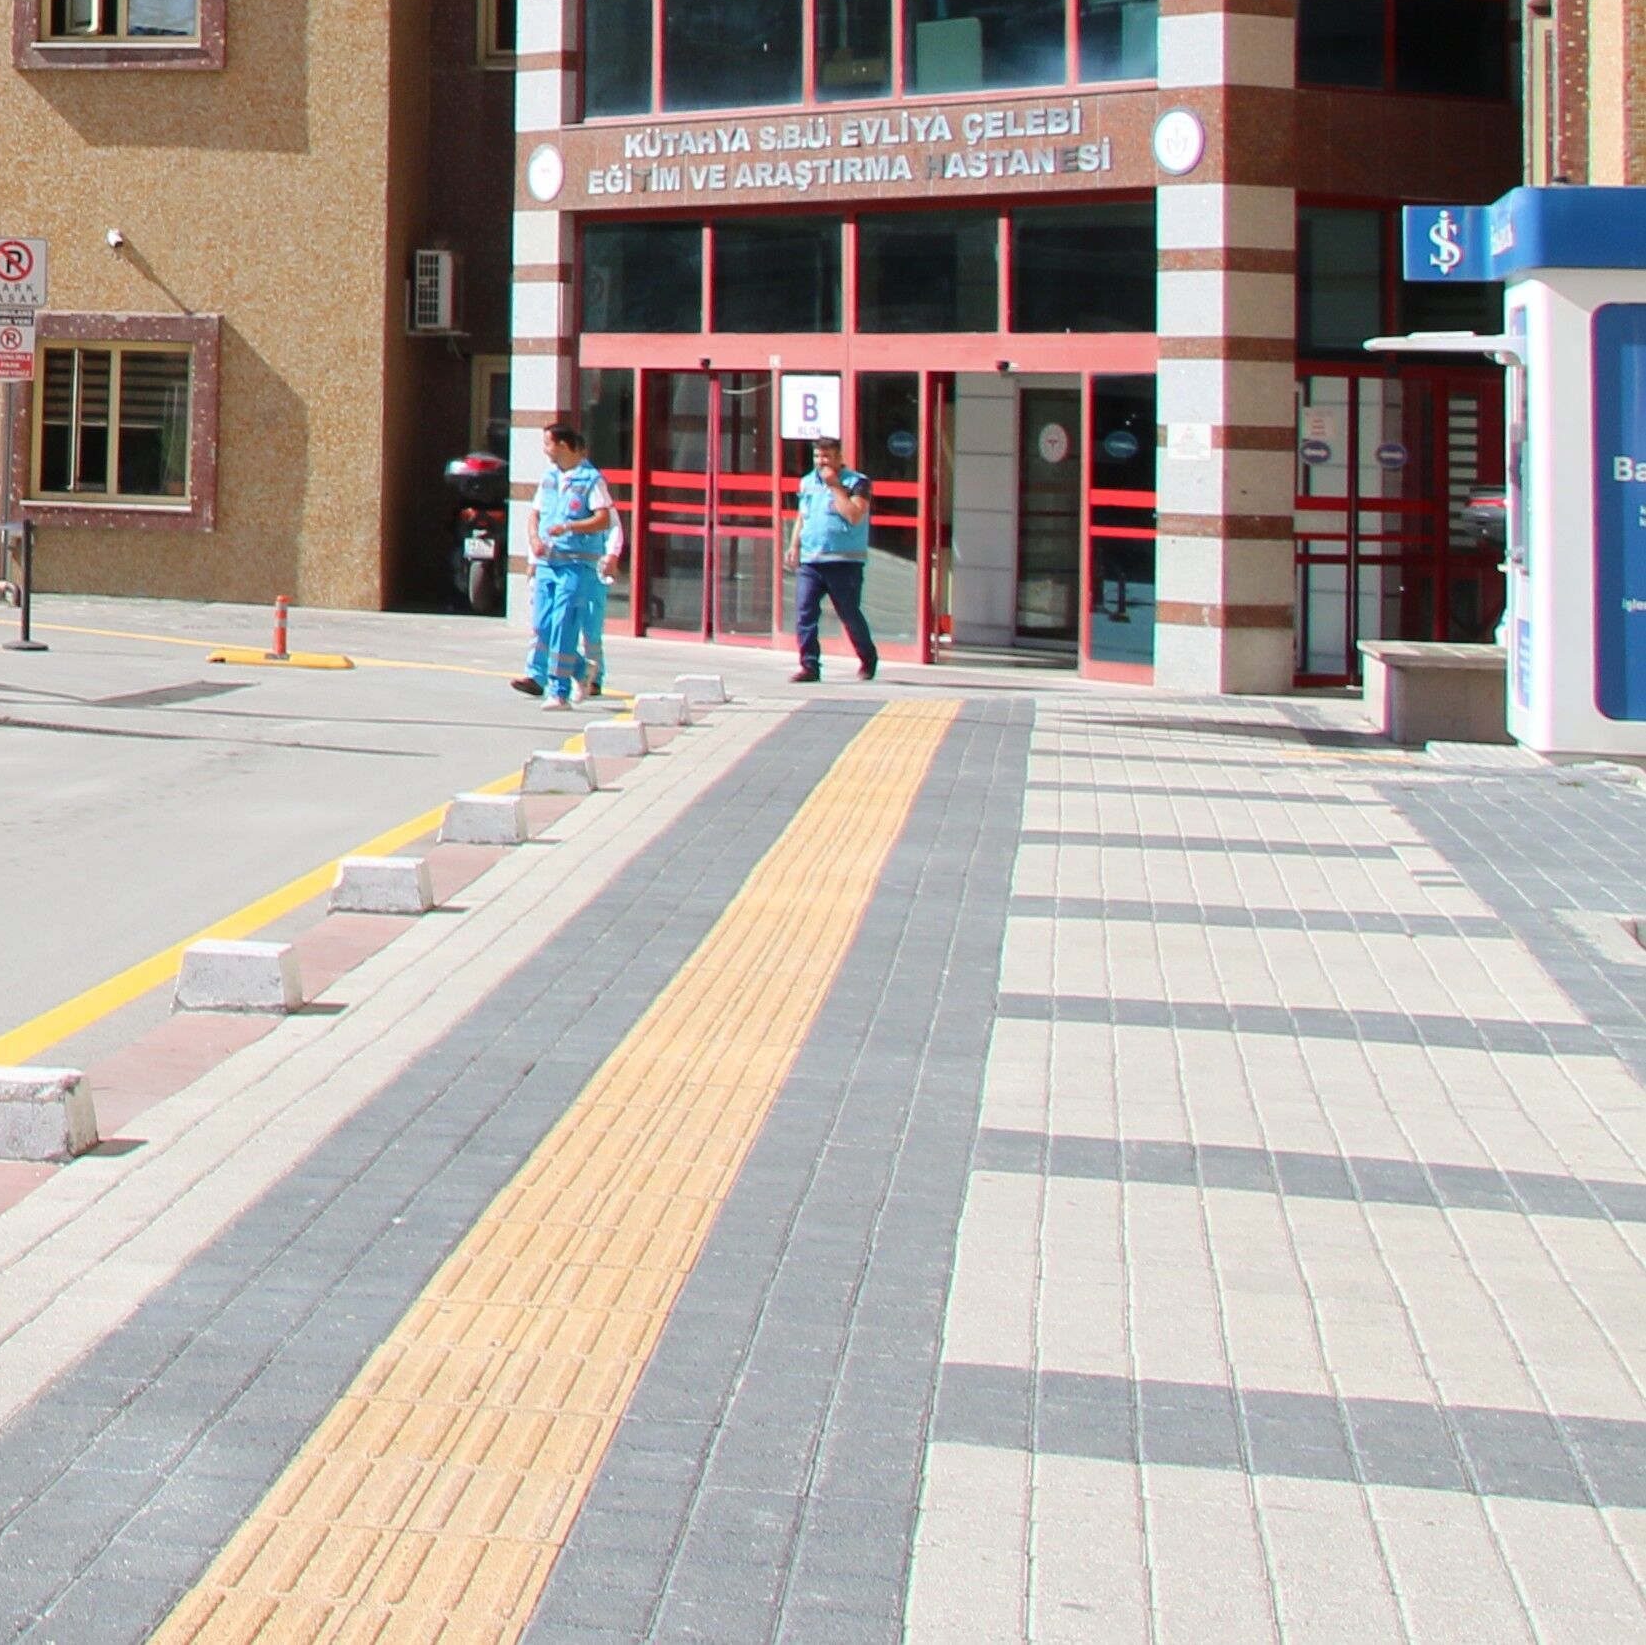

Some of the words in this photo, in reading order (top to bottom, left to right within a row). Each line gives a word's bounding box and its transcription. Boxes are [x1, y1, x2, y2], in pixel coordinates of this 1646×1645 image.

[624, 127, 751, 159] KÜTAHYA
[759, 116, 831, 151] S.B.Ü.
[840, 110, 953, 148] EVLİYA
[961, 99, 1082, 146] ÇELEBİ
[587, 162, 681, 195] EĞİTİM
[689, 163, 727, 191] VE
[733, 154, 913, 192] ARAŞTIRMA
[926, 136, 1112, 180] HASTANESİ
[802, 393, 818, 422] B
